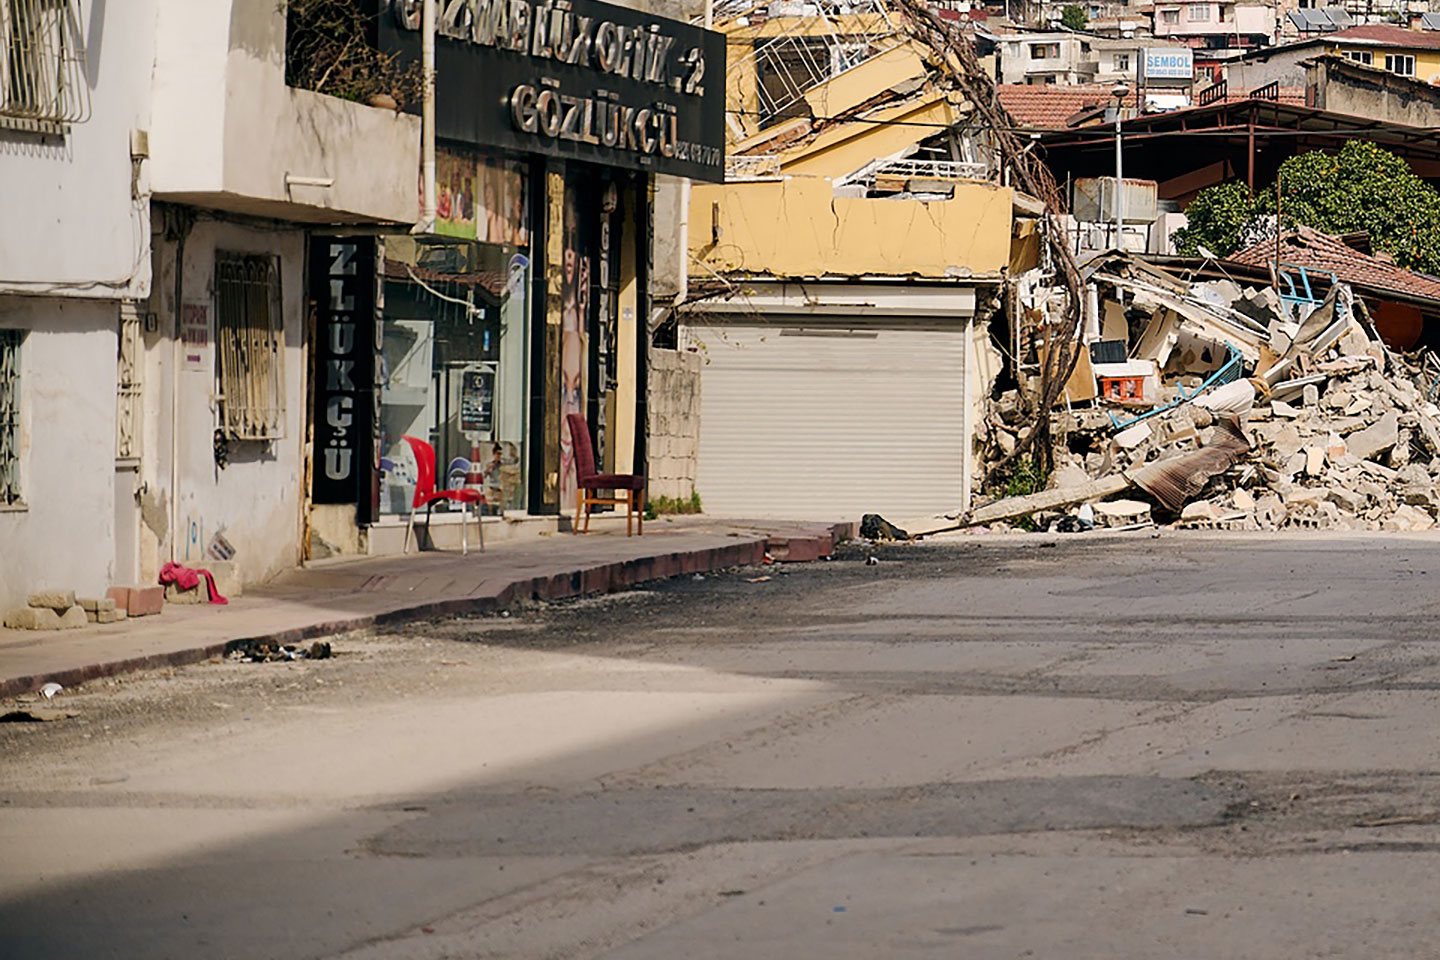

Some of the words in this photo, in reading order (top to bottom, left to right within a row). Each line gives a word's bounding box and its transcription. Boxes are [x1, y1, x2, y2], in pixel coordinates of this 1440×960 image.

[1147, 56, 1190, 67] SEMBOL
[510, 76, 678, 165] GÖZLÜKÇÜ
[324, 244, 357, 481] ZLÜKÇÜ
